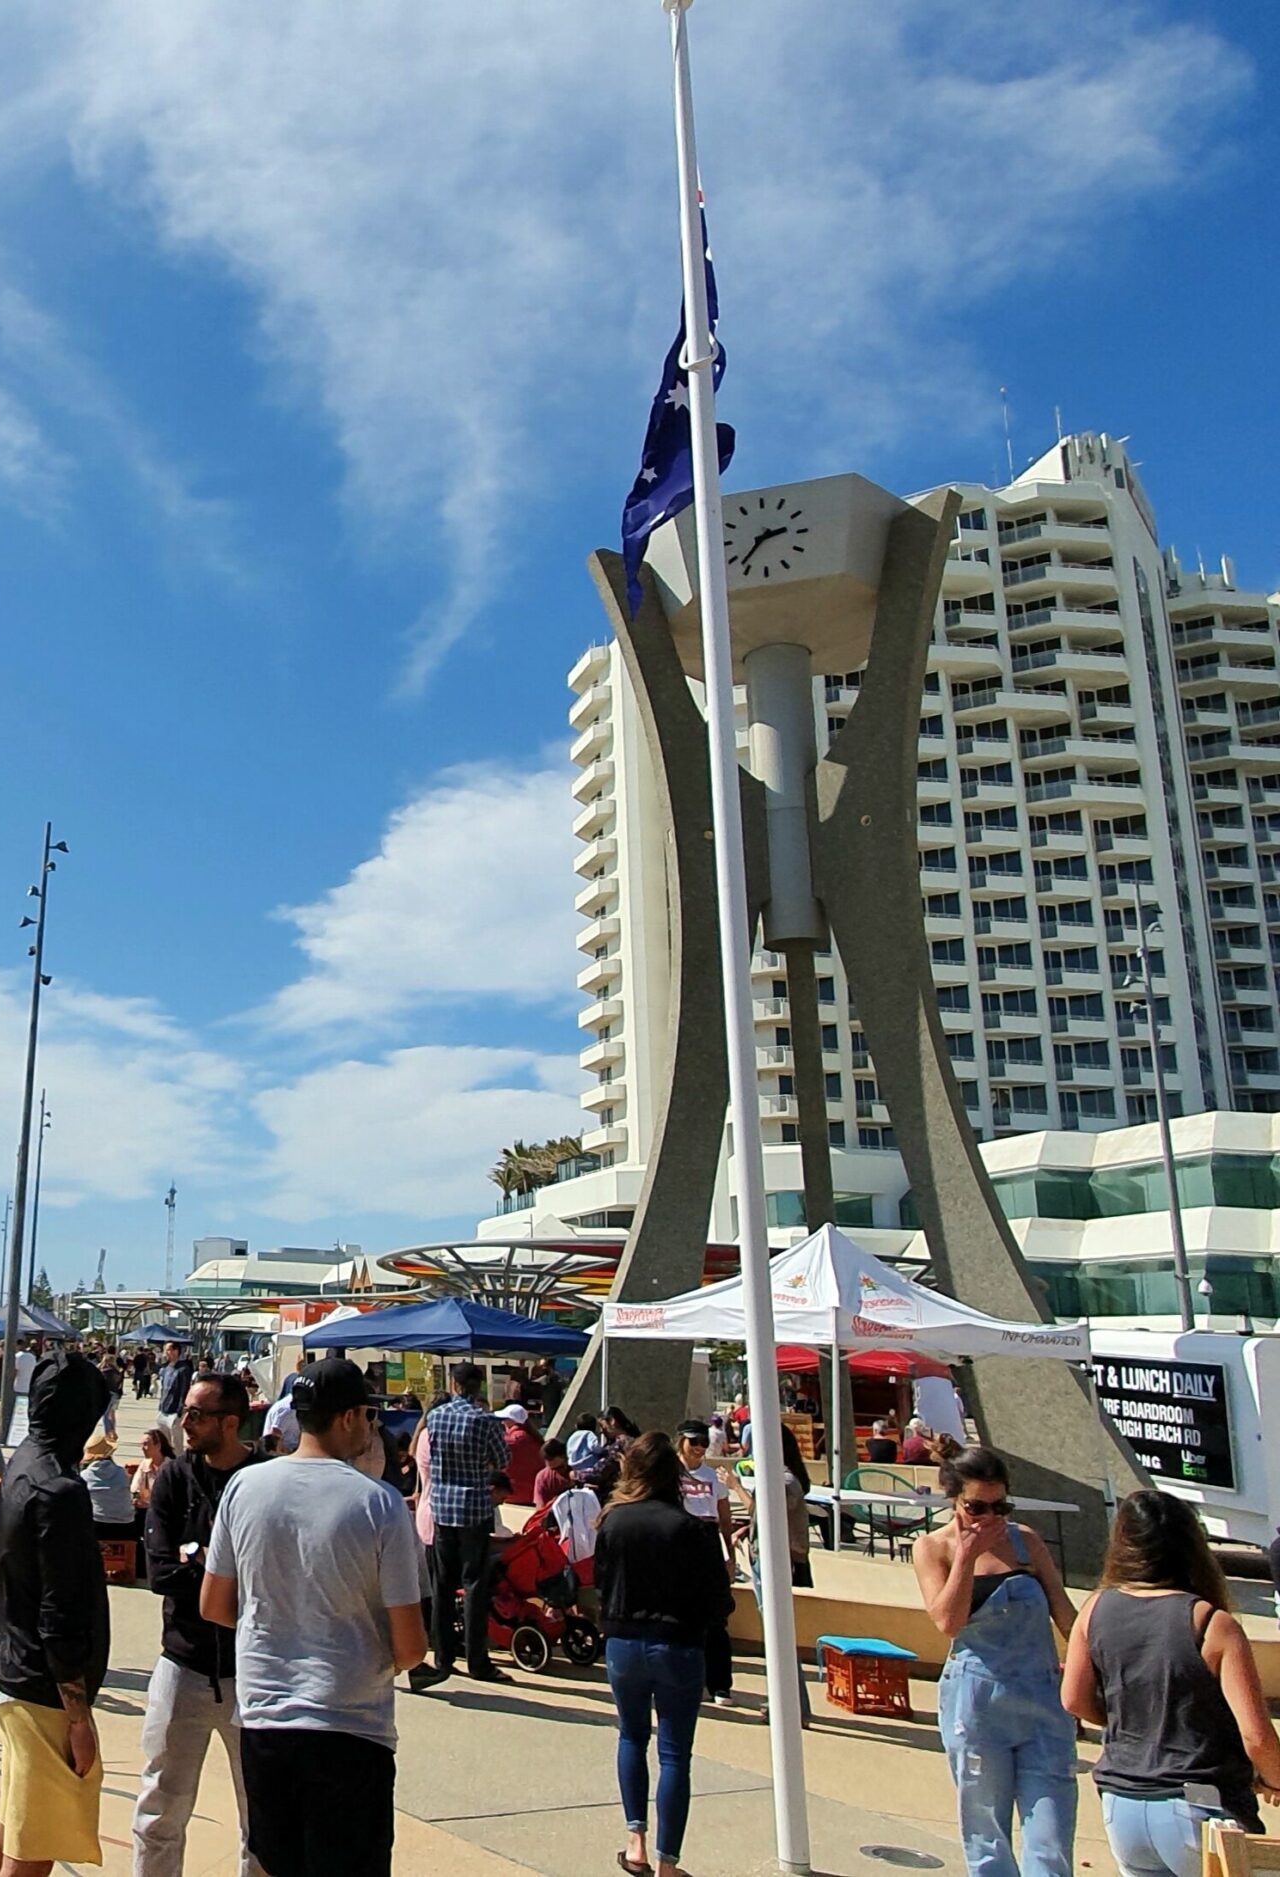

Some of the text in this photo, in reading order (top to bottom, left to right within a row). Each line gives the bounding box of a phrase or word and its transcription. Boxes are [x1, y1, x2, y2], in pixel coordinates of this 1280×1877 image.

[1001, 1330, 1082, 1347] INFORMATION
[1107, 1365, 1119, 1388] &
[1121, 1366, 1170, 1393] LUNCH
[1172, 1371, 1216, 1397] DAILY
[1122, 1400, 1194, 1425] BOARDROOM
[1144, 1422, 1182, 1445] BEACH
[1184, 1428, 1201, 1446] RD
[1181, 1449, 1206, 1465] Uber
